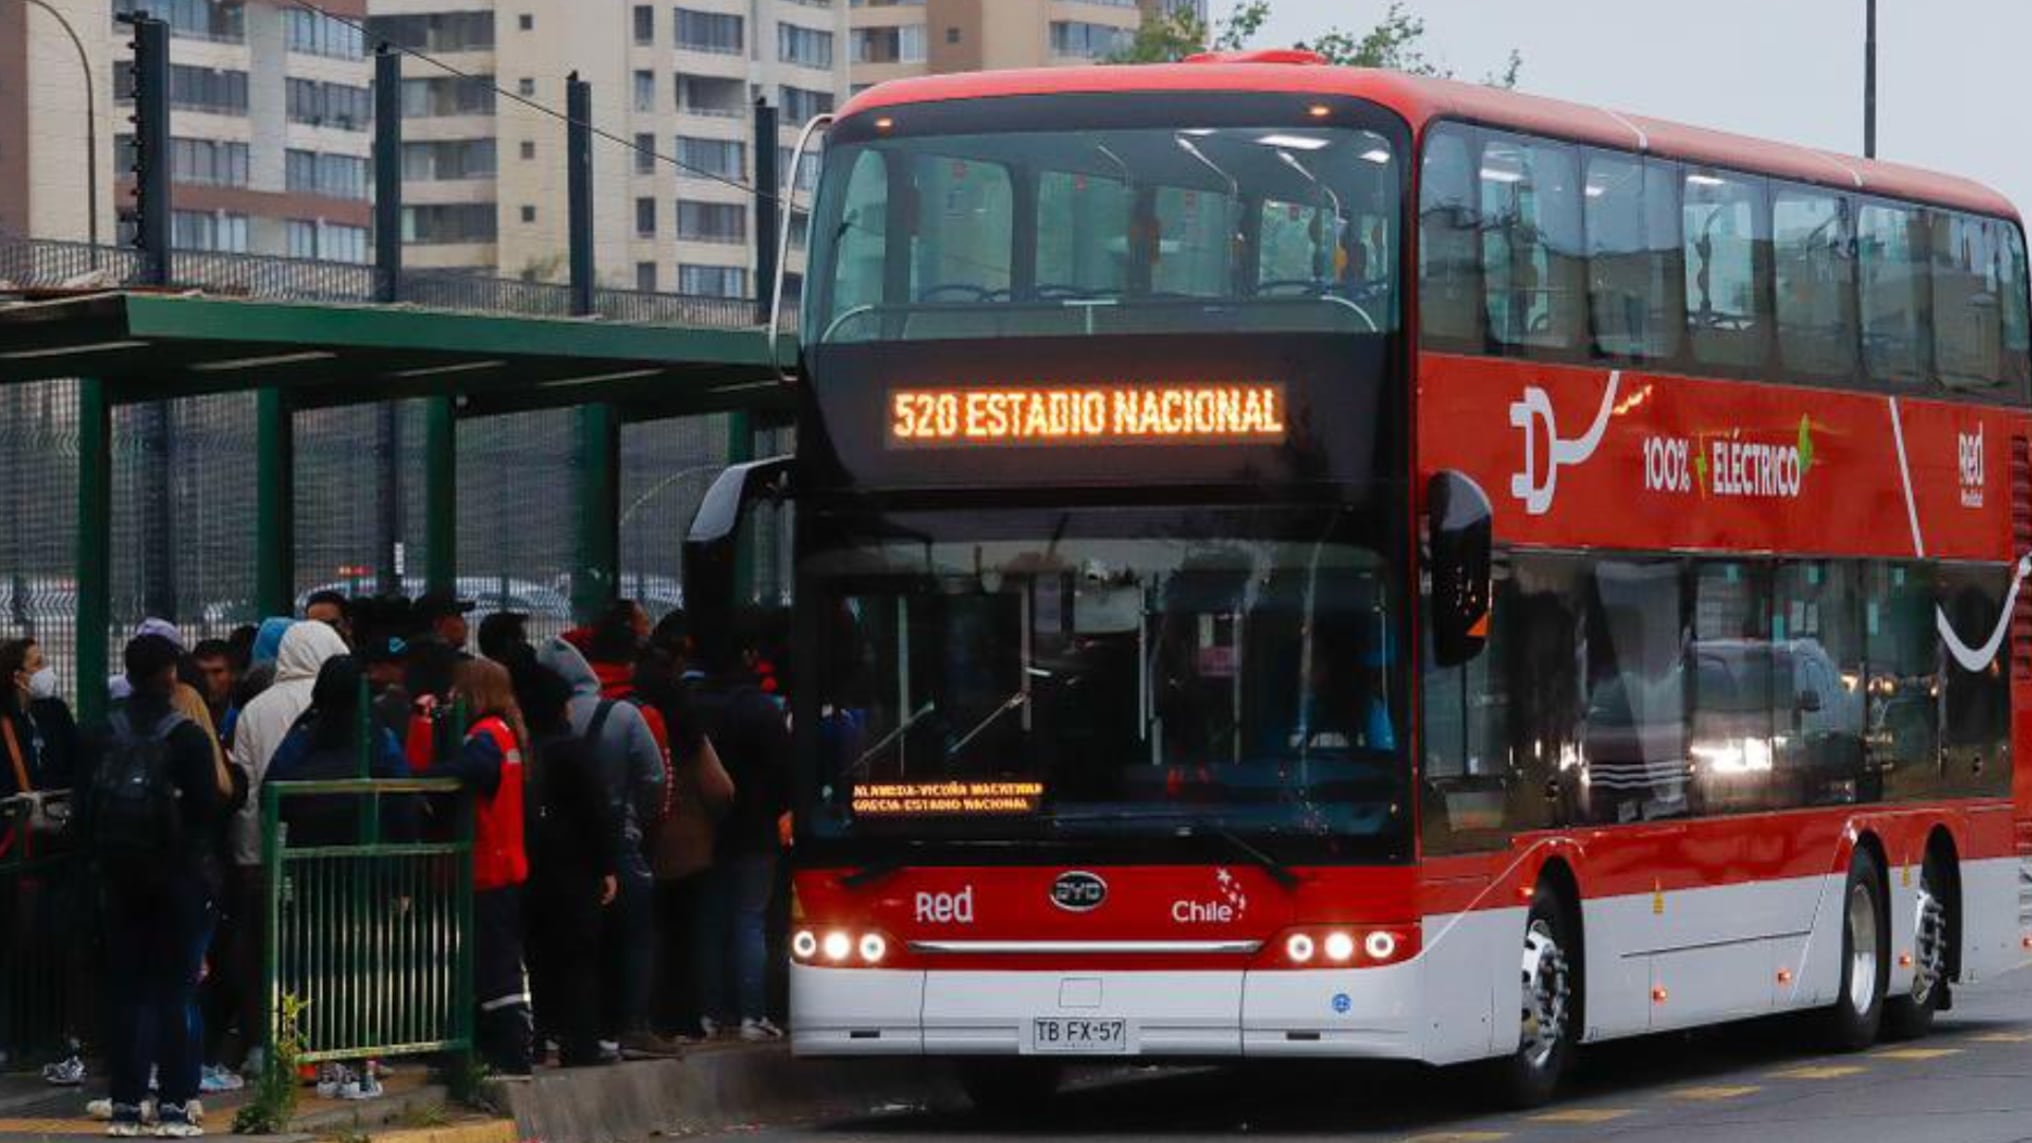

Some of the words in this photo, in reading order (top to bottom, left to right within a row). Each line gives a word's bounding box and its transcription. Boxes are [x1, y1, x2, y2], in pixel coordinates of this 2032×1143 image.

[894, 393, 957, 437] 520
[965, 392, 1106, 436] ESTADIO
[1112, 389, 1283, 434] NACIONAL
[1643, 436, 1692, 493] 100%
[1713, 427, 1801, 497] ELÉCTRICO
[1958, 420, 1984, 486] Red
[962, 798, 1029, 811] NACIONAL
[915, 885, 974, 923] Red
[1055, 881, 1101, 900] BYD
[1171, 899, 1233, 922] Chile
[1037, 1021, 1059, 1041] TB
